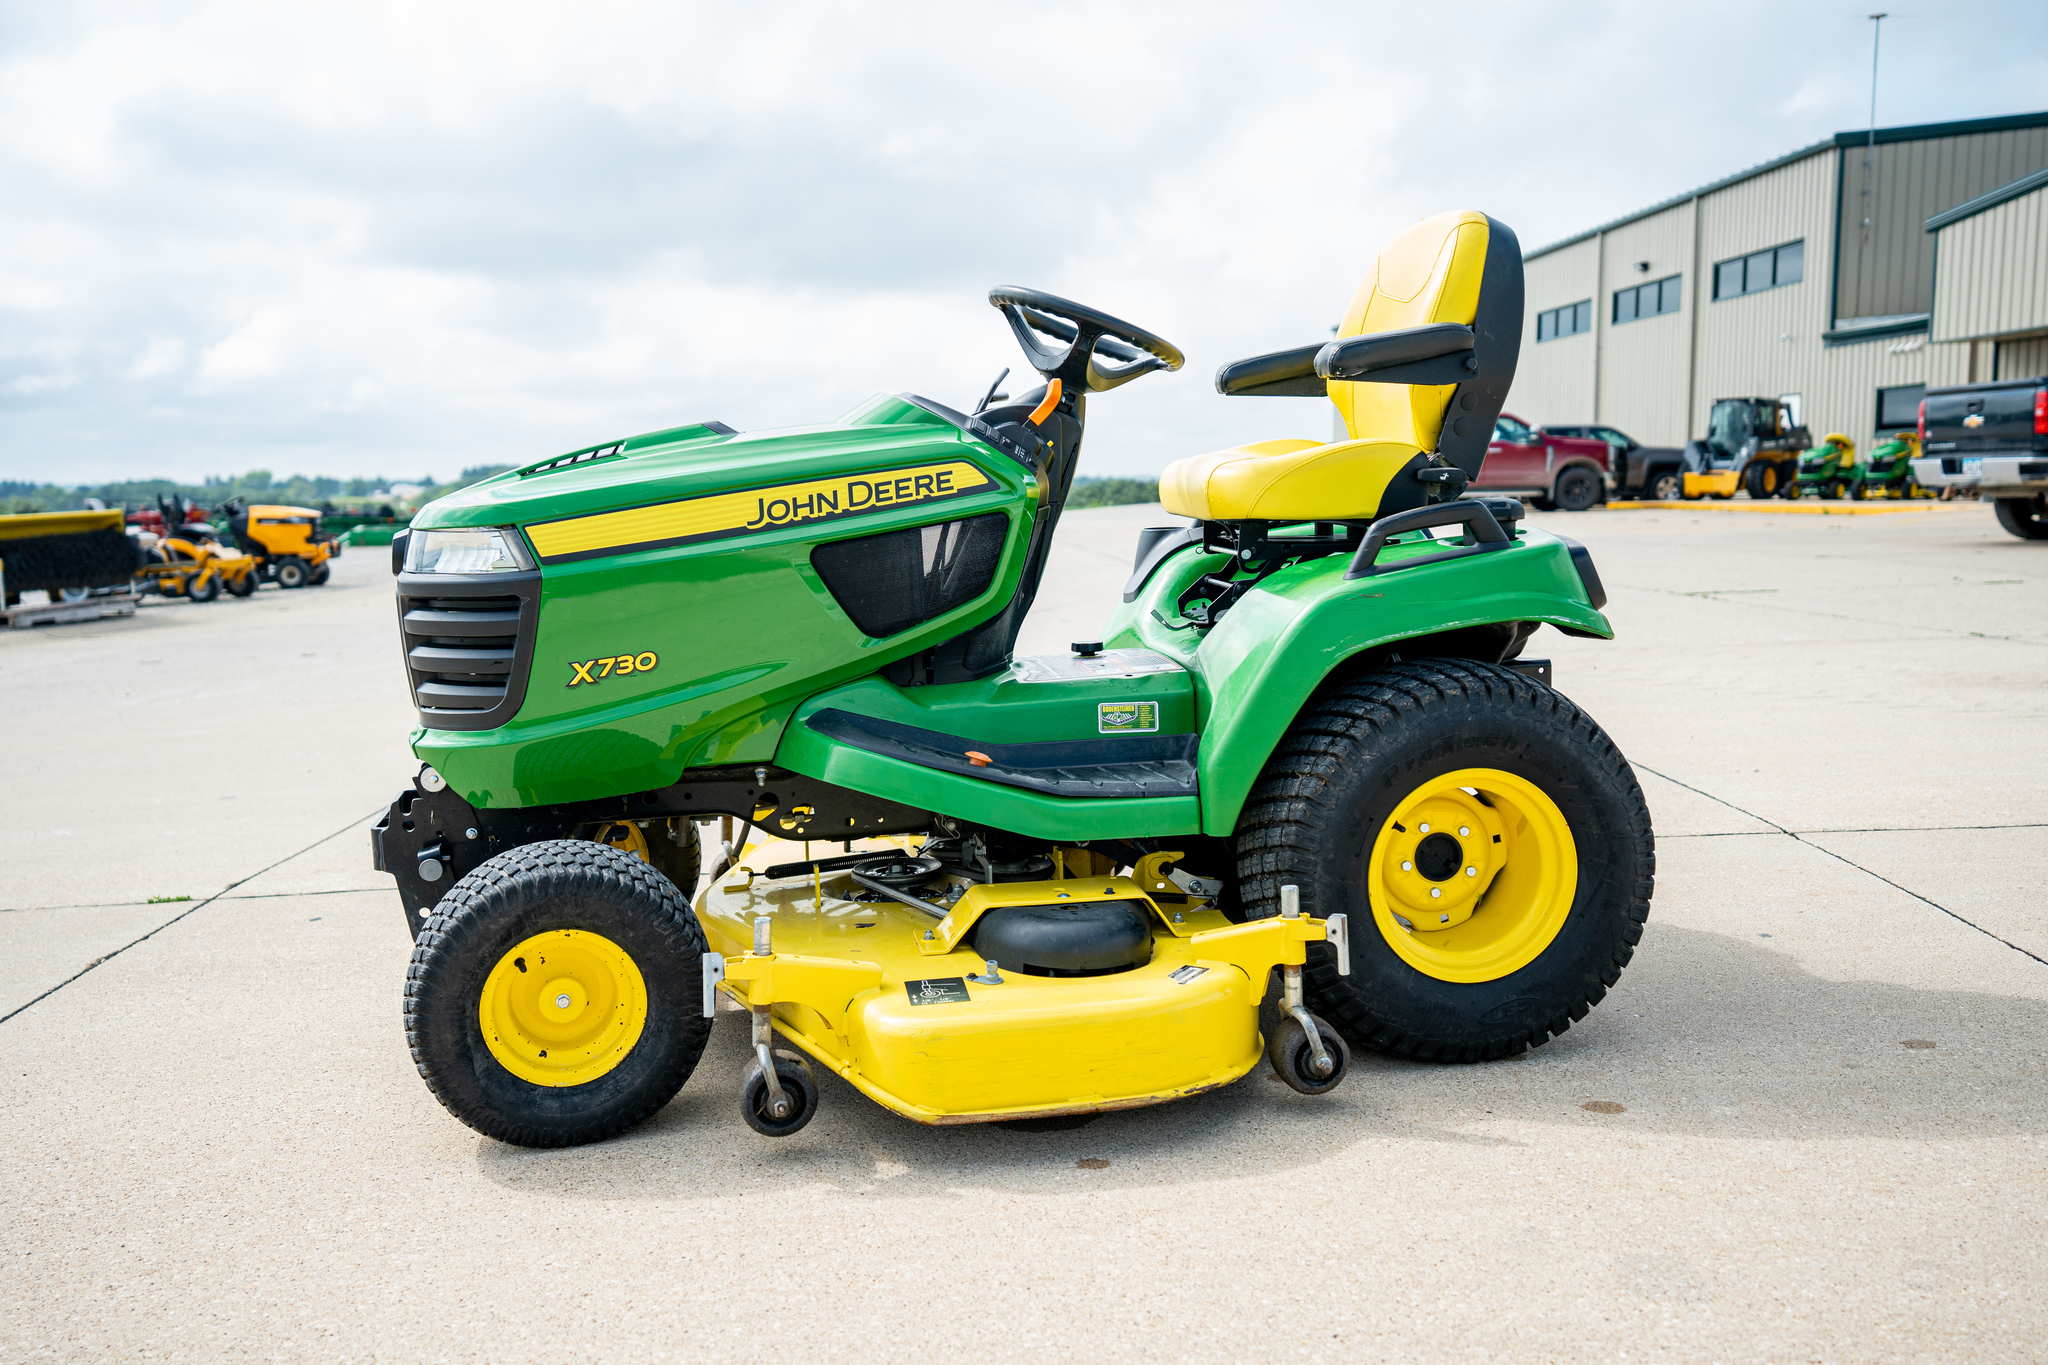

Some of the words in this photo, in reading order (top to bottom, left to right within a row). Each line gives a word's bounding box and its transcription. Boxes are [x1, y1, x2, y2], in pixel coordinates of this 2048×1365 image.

[747, 490, 841, 528] JOHN
[848, 470, 956, 509] DEERE
[566, 651, 659, 688] X730
